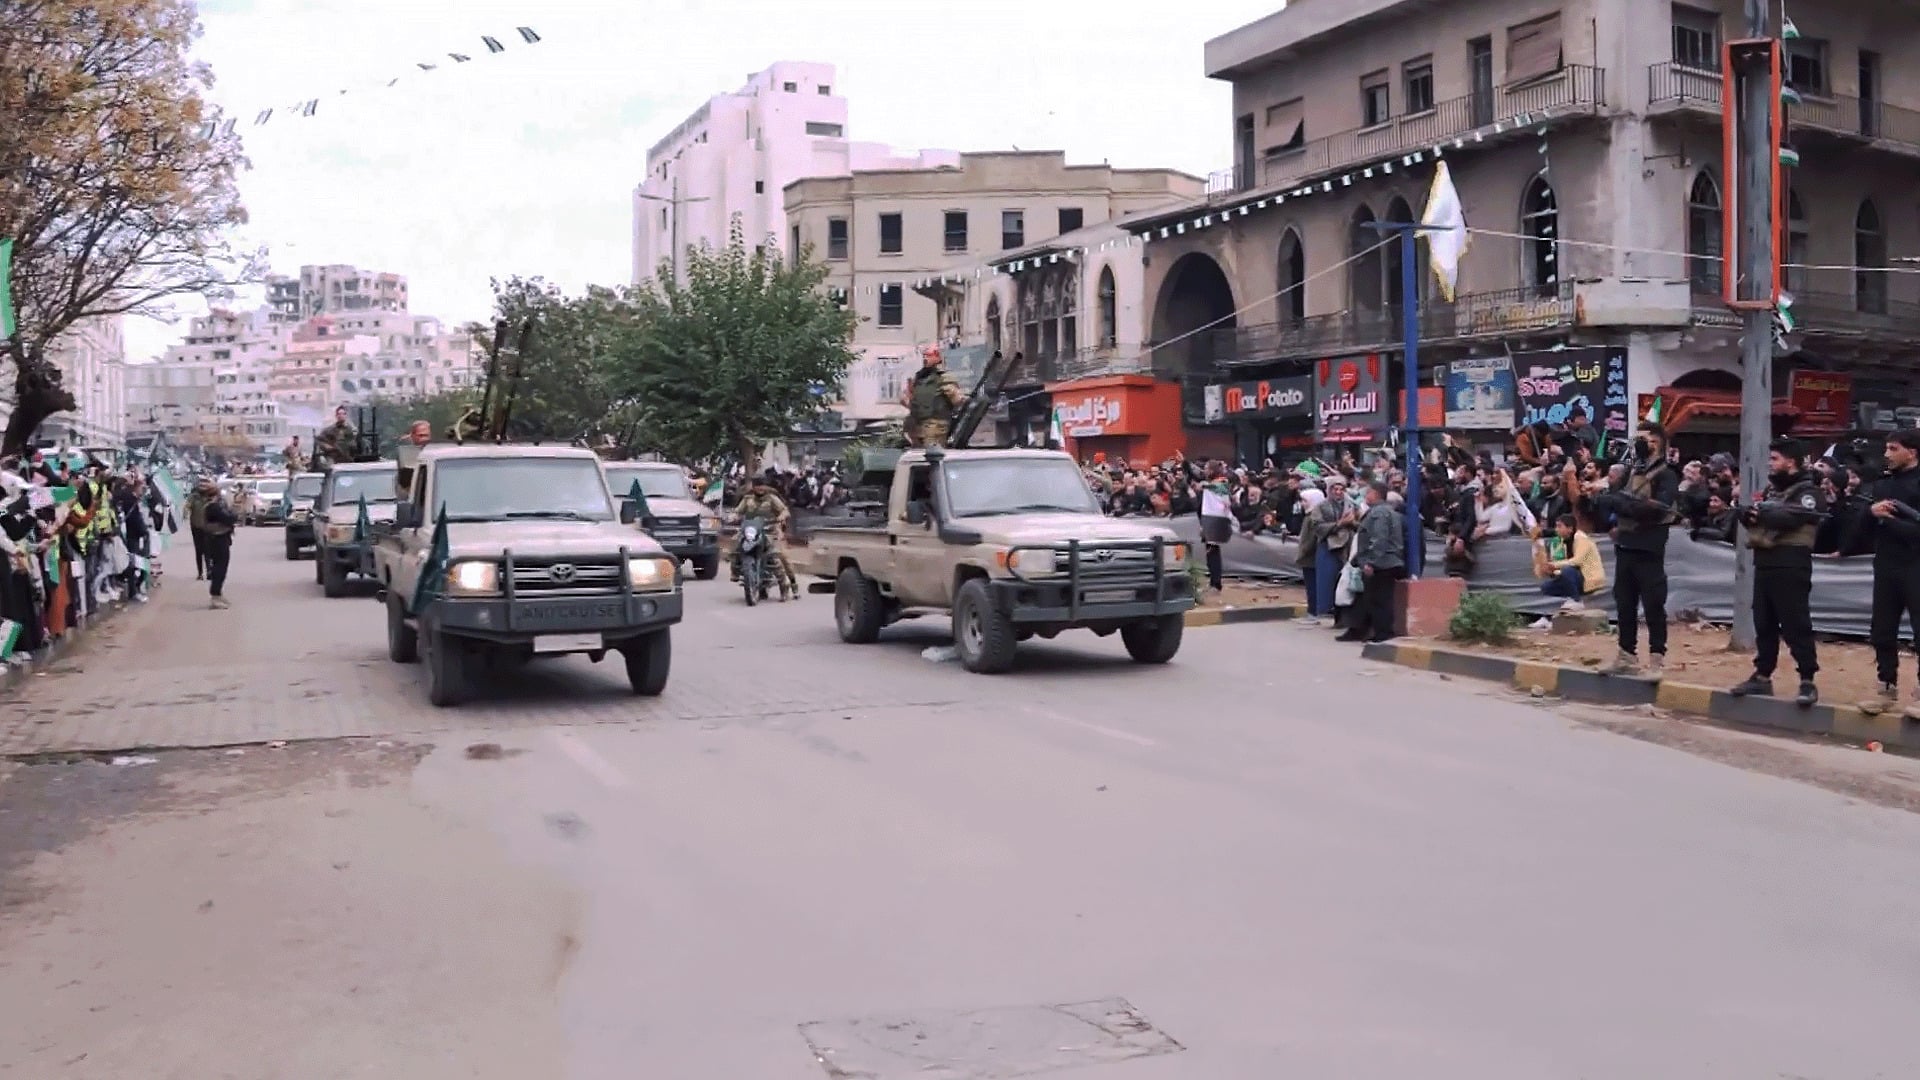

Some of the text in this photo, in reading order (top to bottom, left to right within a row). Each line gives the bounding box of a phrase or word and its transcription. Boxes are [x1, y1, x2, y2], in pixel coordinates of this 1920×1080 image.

[1226, 380, 1304, 414] Max Potato
[1517, 377, 1561, 397] Star
